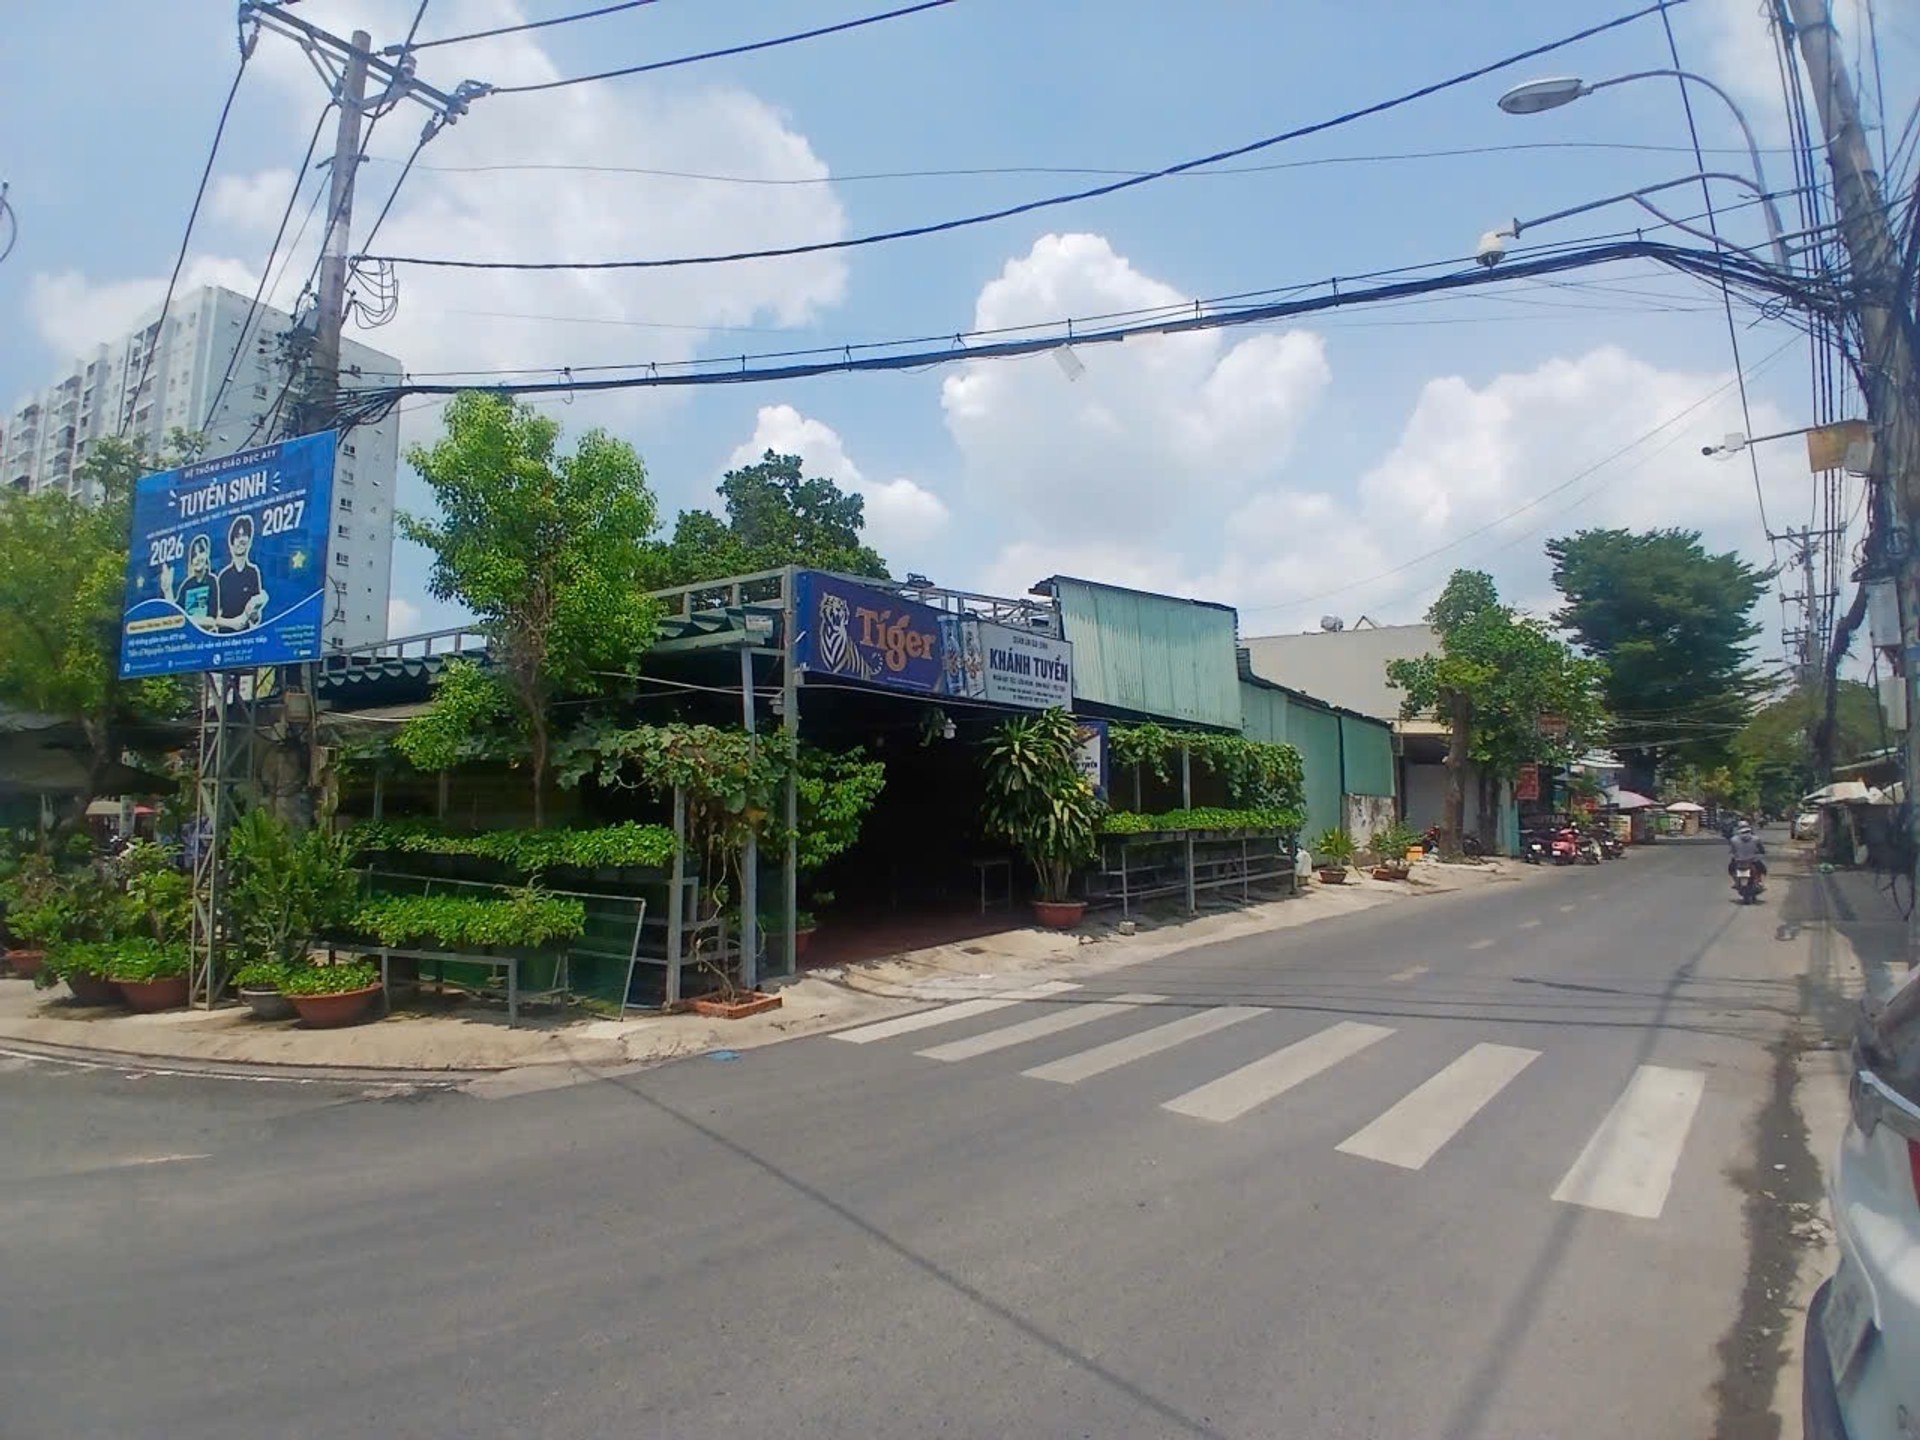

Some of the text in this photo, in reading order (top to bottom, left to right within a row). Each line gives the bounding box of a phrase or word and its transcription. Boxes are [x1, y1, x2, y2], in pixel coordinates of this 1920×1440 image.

[180, 470, 267, 519] TUYỂN SINH
[262, 499, 305, 537] 2027
[150, 533, 184, 567] 2026
[855, 607, 937, 672] Tiger
[990, 647, 1030, 676] KHÁNH
